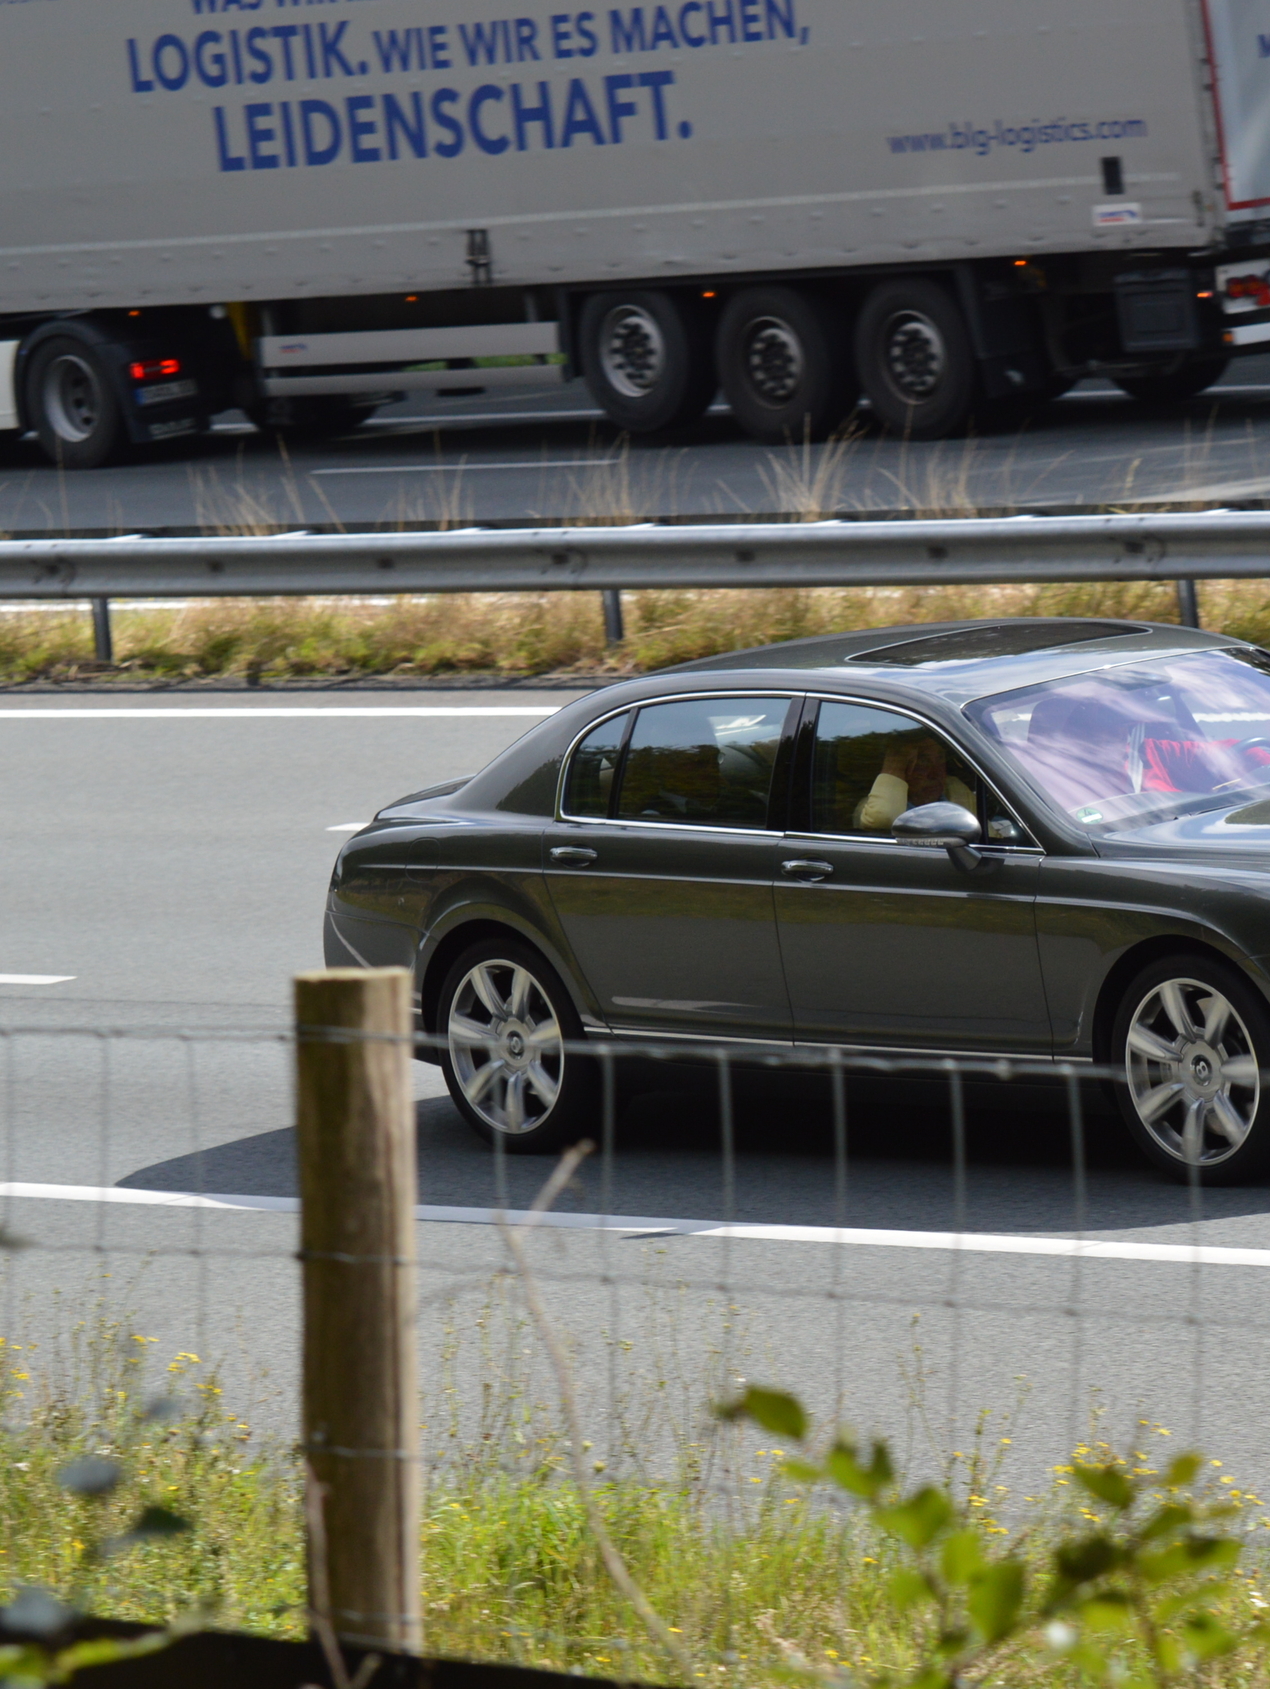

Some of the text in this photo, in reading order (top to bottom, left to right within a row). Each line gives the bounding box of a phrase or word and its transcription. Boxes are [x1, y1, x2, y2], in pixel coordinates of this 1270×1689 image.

[126, 0, 812, 93] LOGISTIK. WIE WIR ES MACHEN,
[212, 70, 695, 173] LEIDENSCHAFT.
[887, 116, 1148, 157] www.blg-logistics.com
